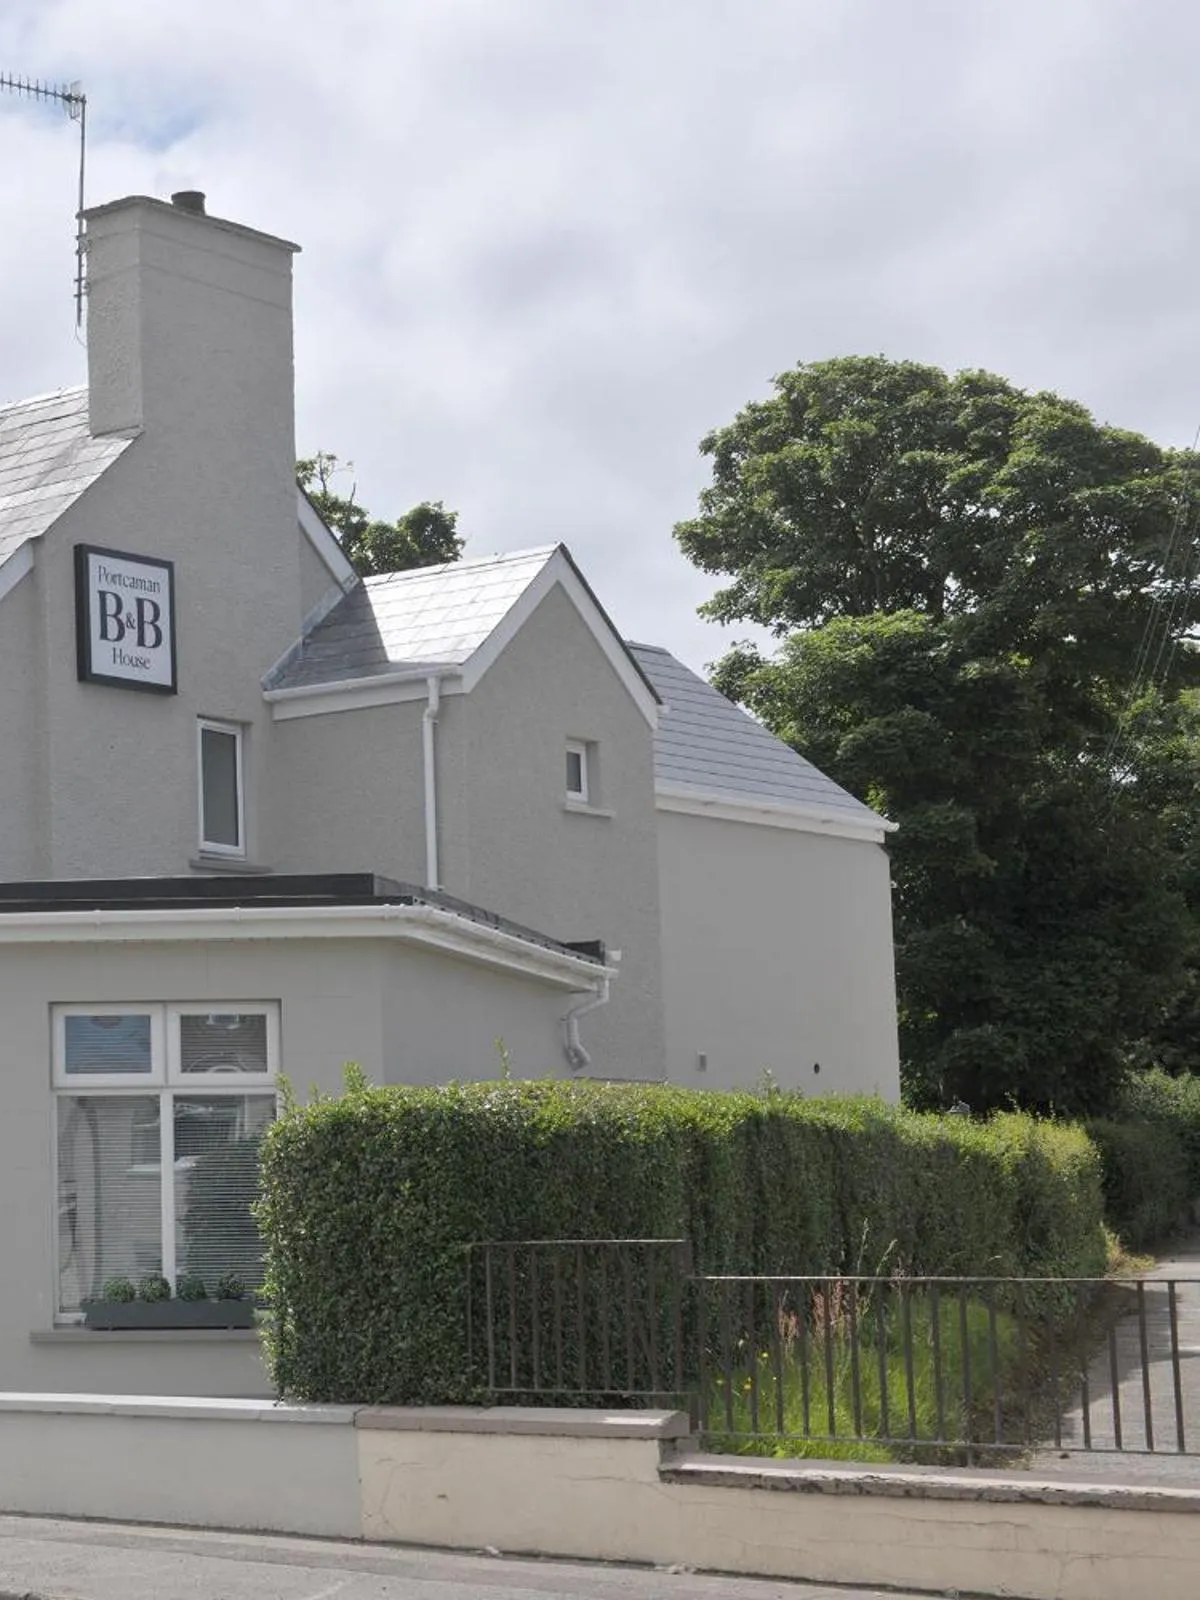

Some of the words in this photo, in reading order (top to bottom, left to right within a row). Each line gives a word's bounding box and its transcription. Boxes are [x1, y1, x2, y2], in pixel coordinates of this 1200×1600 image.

[98, 564, 161, 593] Portcaman
[97, 590, 163, 649] B&B
[112, 647, 151, 670] House
